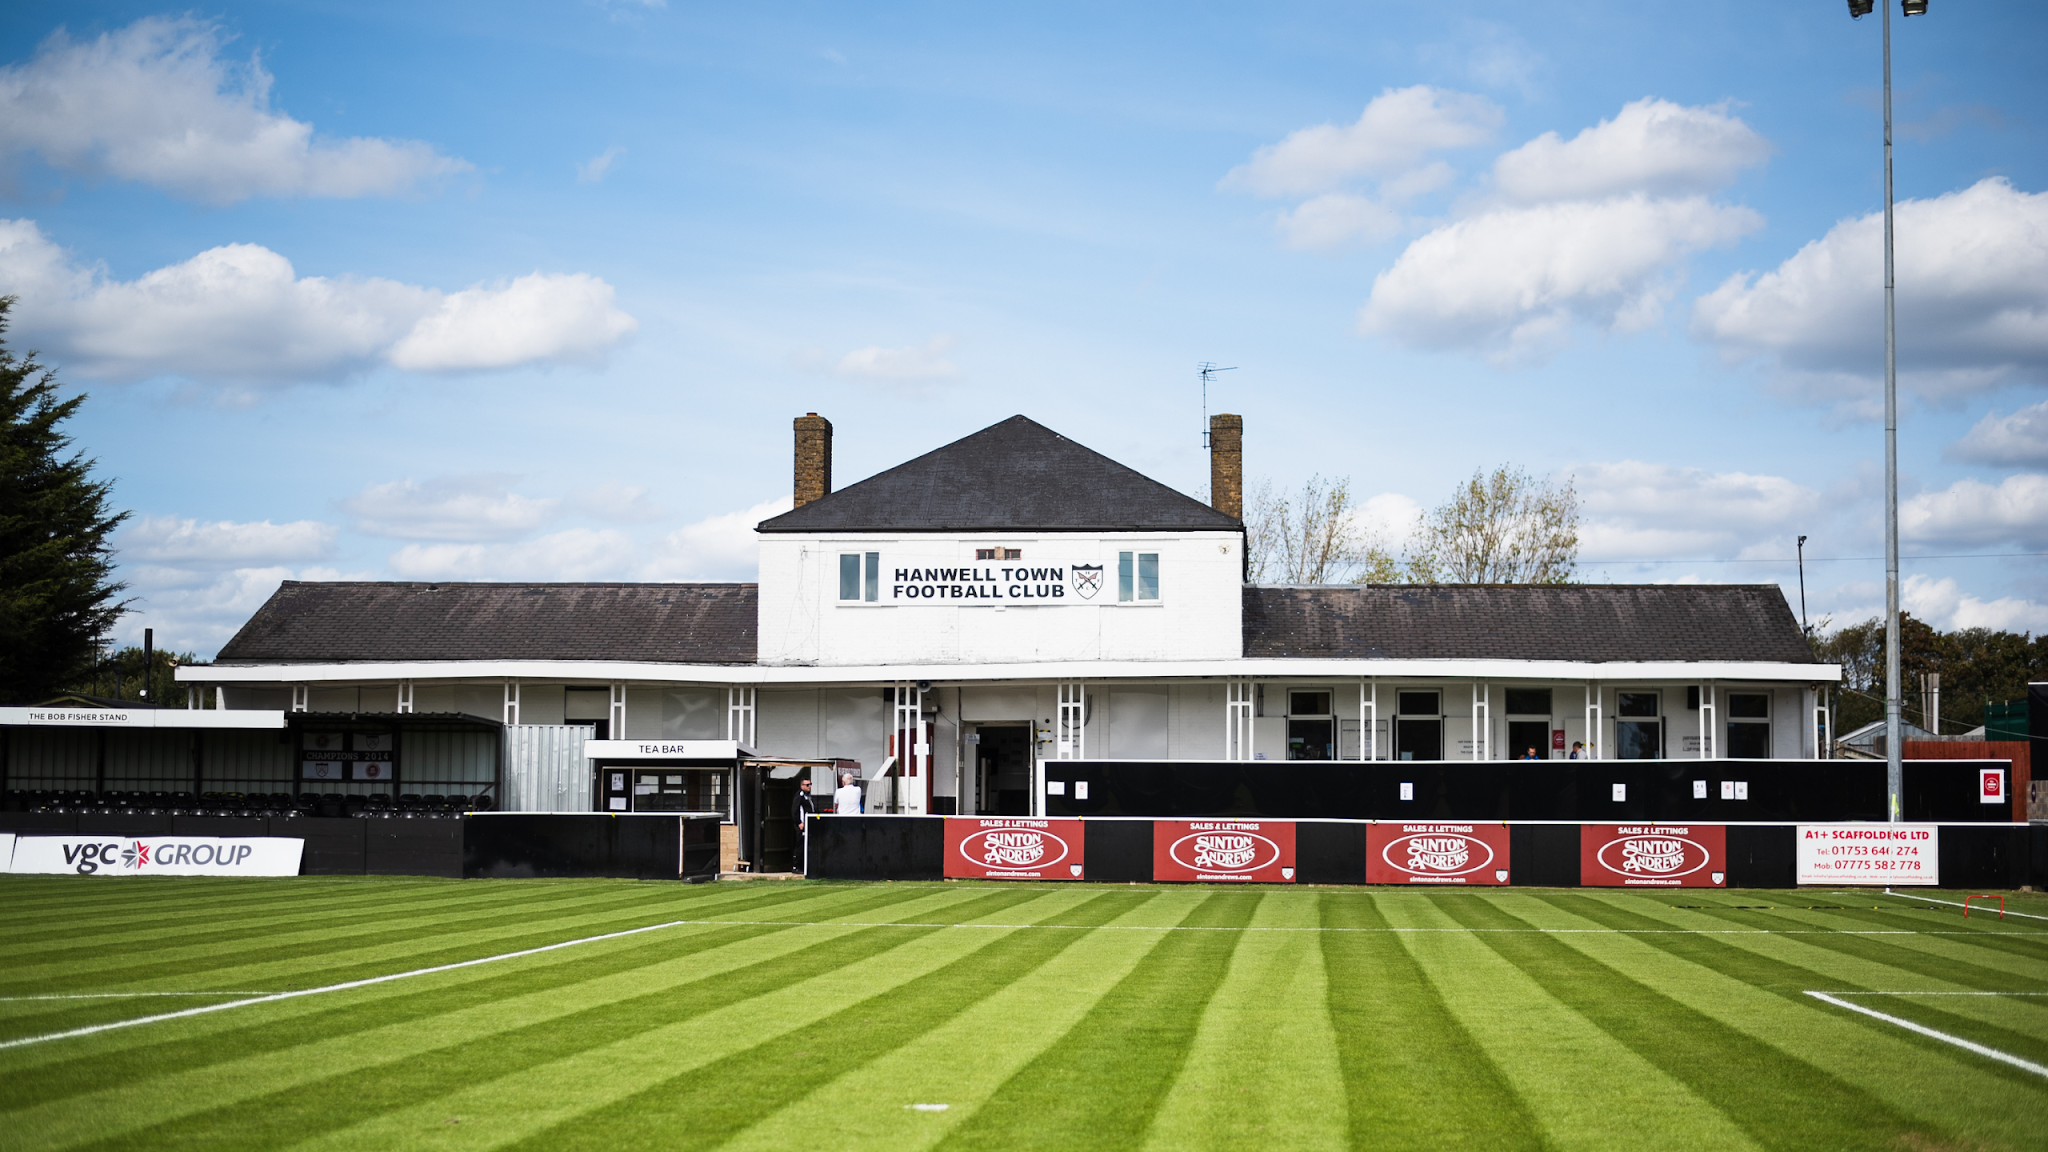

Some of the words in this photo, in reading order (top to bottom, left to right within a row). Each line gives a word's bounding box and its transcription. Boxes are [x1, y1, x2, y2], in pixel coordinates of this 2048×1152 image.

[895, 568, 996, 582] HANWELL
[1001, 568, 1064, 582] TOWN
[893, 584, 1003, 598] FOOTBALL
[1008, 584, 1065, 598] CLUB
[68, 713, 98, 721] FISHER
[306, 751, 359, 760] CHAMPIONS
[364, 752, 389, 760] 2014
[639, 745, 659, 754] TEA
[662, 745, 685, 754] BAR
[980, 820, 1004, 828] SALES
[1004, 820, 1011, 828] &
[1012, 820, 1049, 828] LETTINGS
[1190, 822, 1214, 830] SALES
[1222, 823, 1260, 831] LETTINGS
[1435, 825, 1473, 833] LETTINGS
[984, 833, 1044, 850] SINTON
[1805, 830, 1829, 840] A1+
[1832, 830, 1907, 840] SCAFFOLDING
[1911, 831, 1930, 840] LTD
[1194, 836, 1255, 853] SINTON
[1407, 838, 1468, 855] SINTON
[1622, 840, 1684, 858] SINTON
[1816, 848, 1831, 856] Tel:
[1831, 846, 1869, 856] 01753
[1896, 846, 1919, 856] 274
[62, 843, 119, 874] vgc
[154, 844, 252, 866] GROUP
[984, 845, 1044, 865] ANDREWS
[1194, 848, 1255, 868] ANDREWS
[1407, 850, 1469, 870] ANDREWS
[1622, 852, 1685, 872] ANDREWS
[1834, 860, 1871, 870] 07775
[1874, 860, 1896, 870] 582
[1899, 861, 1921, 870] 778
